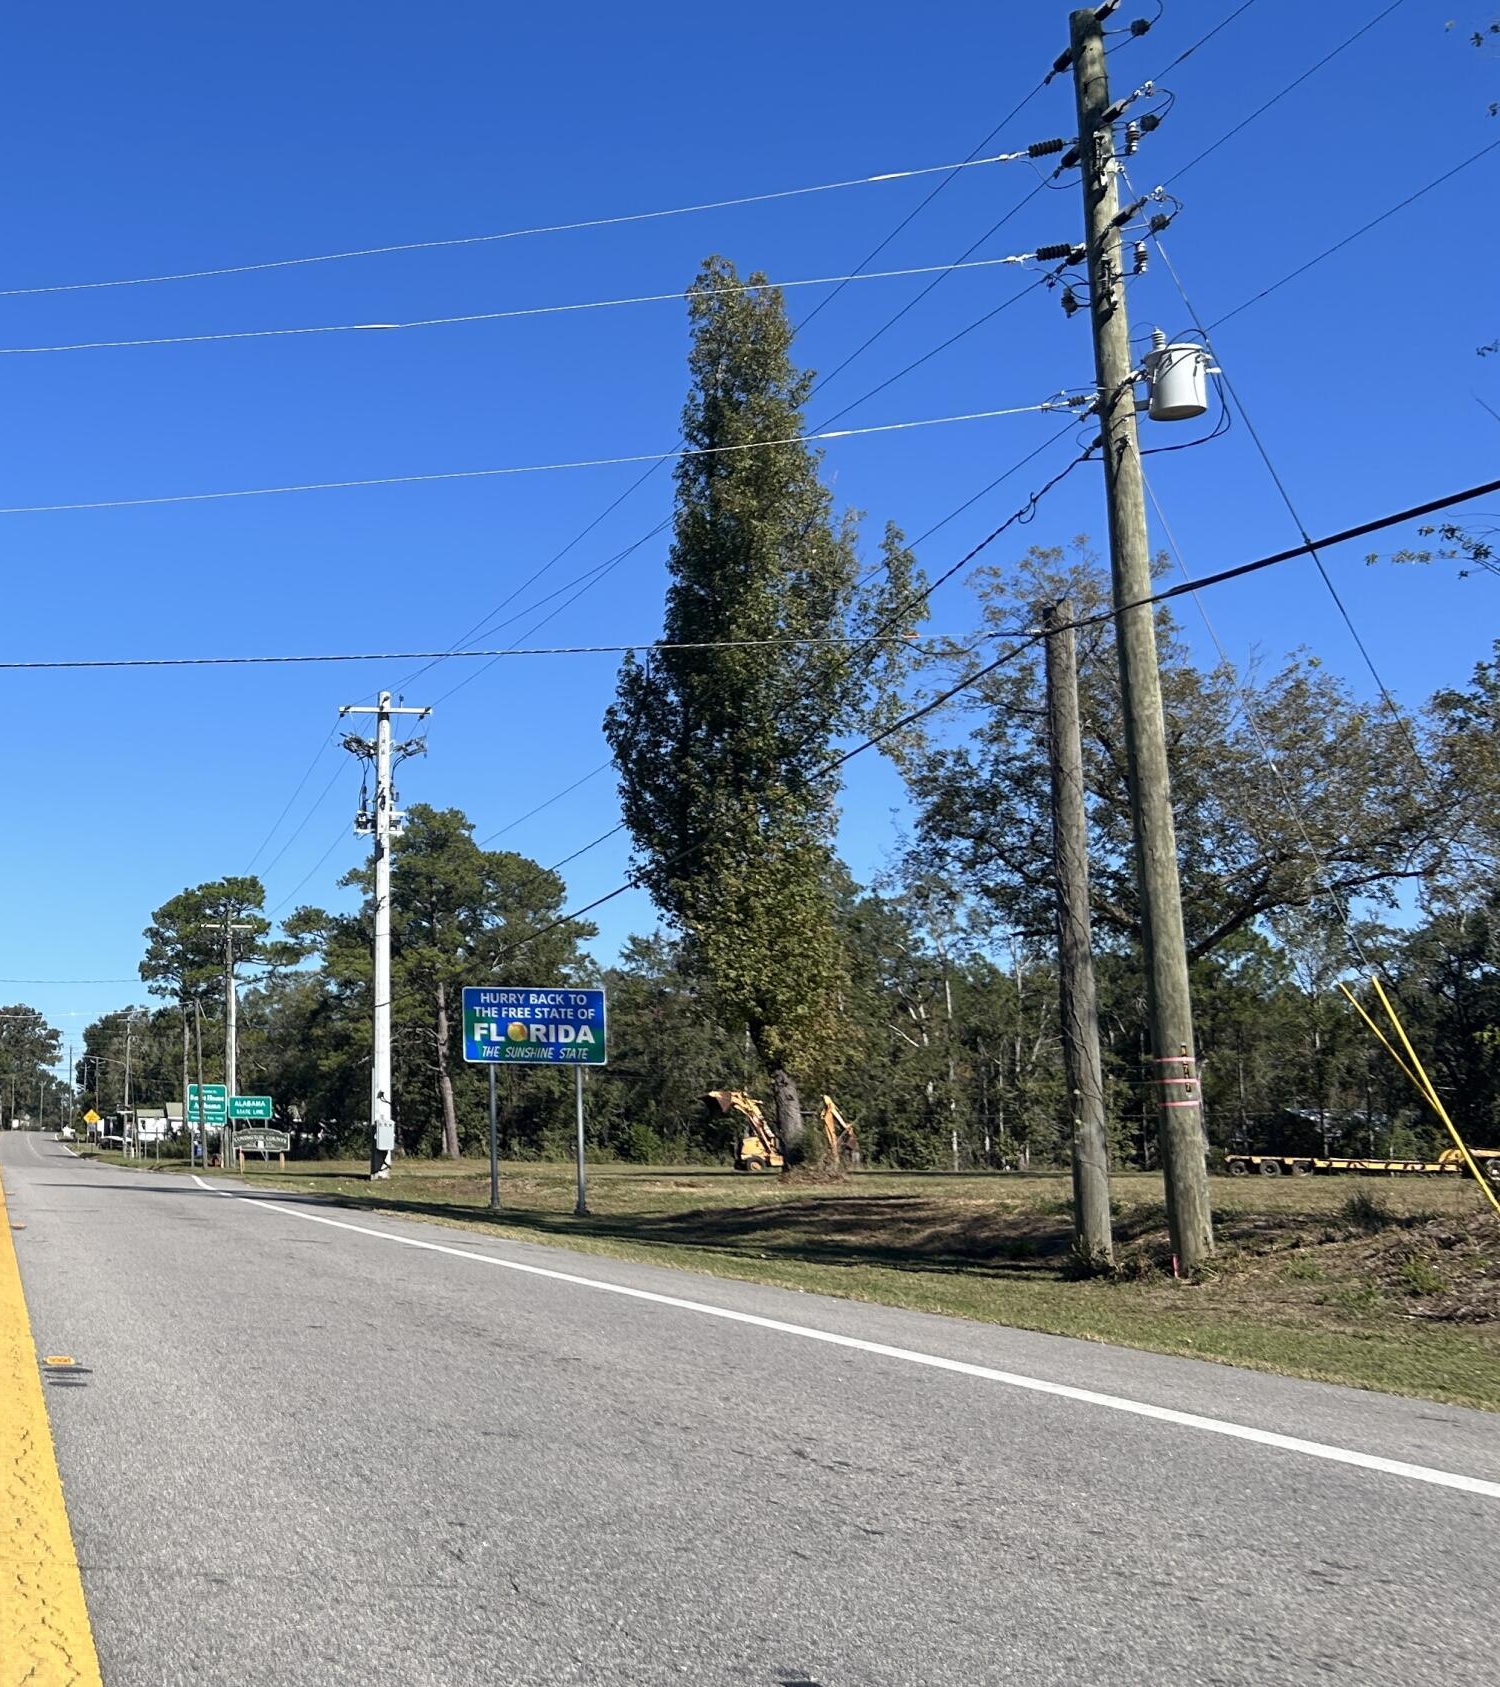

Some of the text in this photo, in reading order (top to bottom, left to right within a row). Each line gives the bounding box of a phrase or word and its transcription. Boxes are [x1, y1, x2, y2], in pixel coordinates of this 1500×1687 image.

[480, 993, 587, 1006] HURRY BACK TO
[474, 1006, 595, 1020] THE FREE STATE OF
[473, 1021, 596, 1044] FLORIDA
[482, 1046, 589, 1060] THE SUNSHINE STATE
